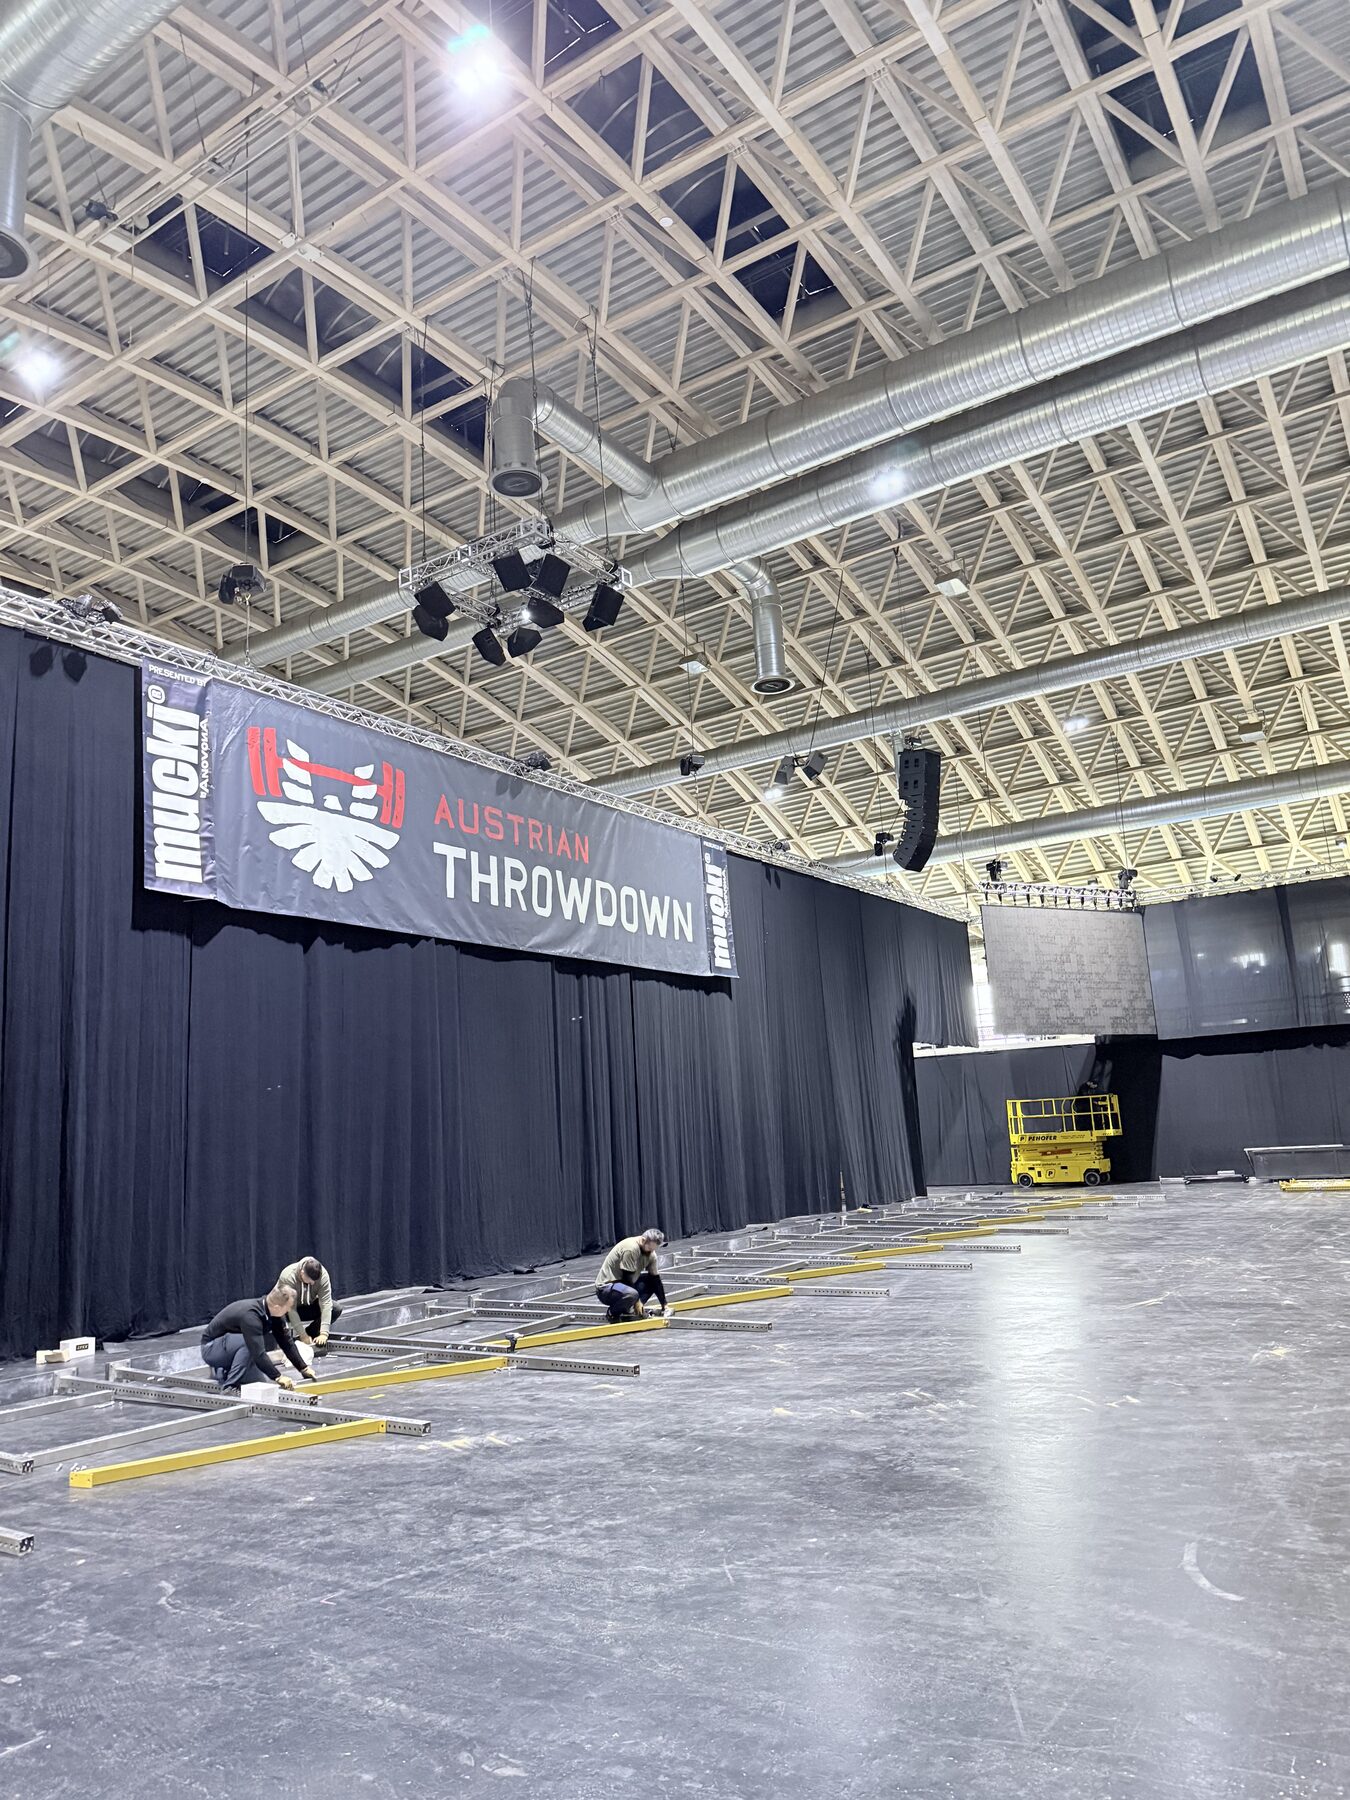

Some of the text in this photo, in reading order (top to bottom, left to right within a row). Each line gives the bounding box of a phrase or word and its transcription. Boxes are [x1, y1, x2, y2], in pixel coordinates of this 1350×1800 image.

[148, 664, 207, 688] PRESENTED BY
[434, 793, 589, 864] AUSTRIAN
[433, 841, 694, 943] THROWDOWN
